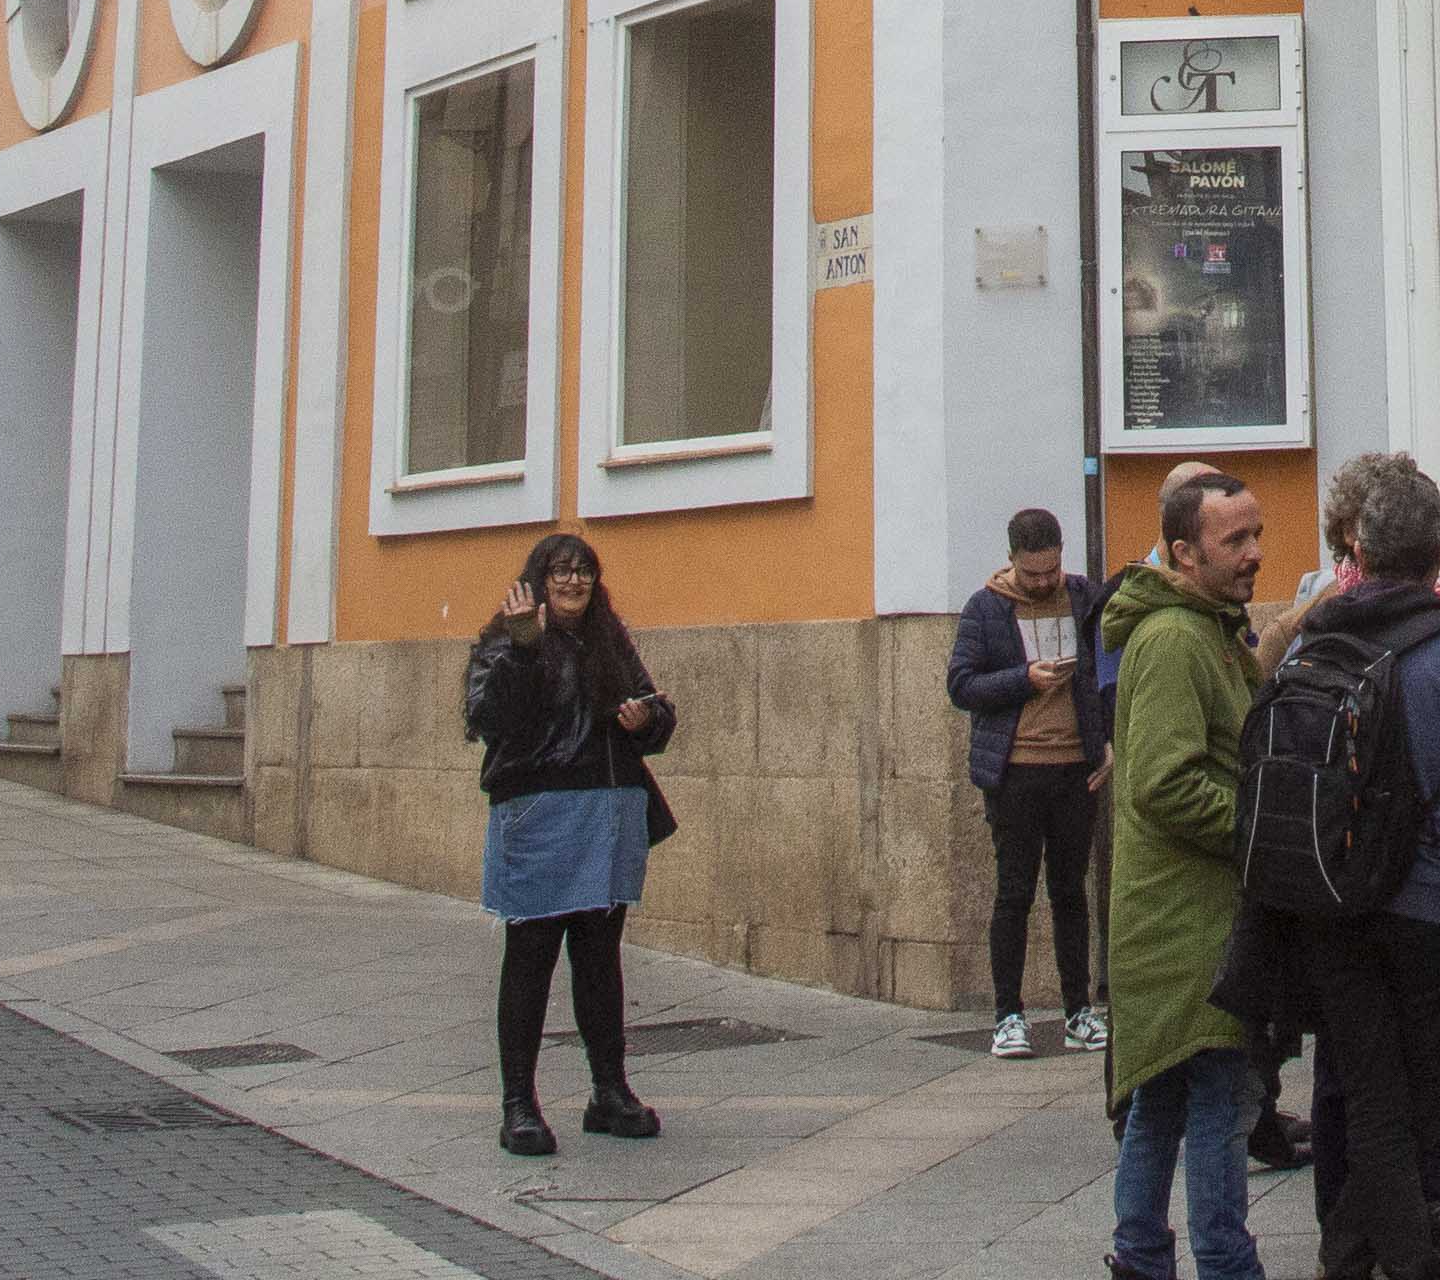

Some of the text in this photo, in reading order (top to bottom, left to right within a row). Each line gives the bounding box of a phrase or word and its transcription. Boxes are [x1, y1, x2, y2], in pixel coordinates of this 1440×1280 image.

[1169, 158, 1237, 175] SALOMÉ
[1190, 172, 1247, 189] PAVÓN
[1123, 204, 1228, 218] EXTREMADURA
[833, 224, 859, 251] SAN
[826, 252, 868, 281] ANTON
